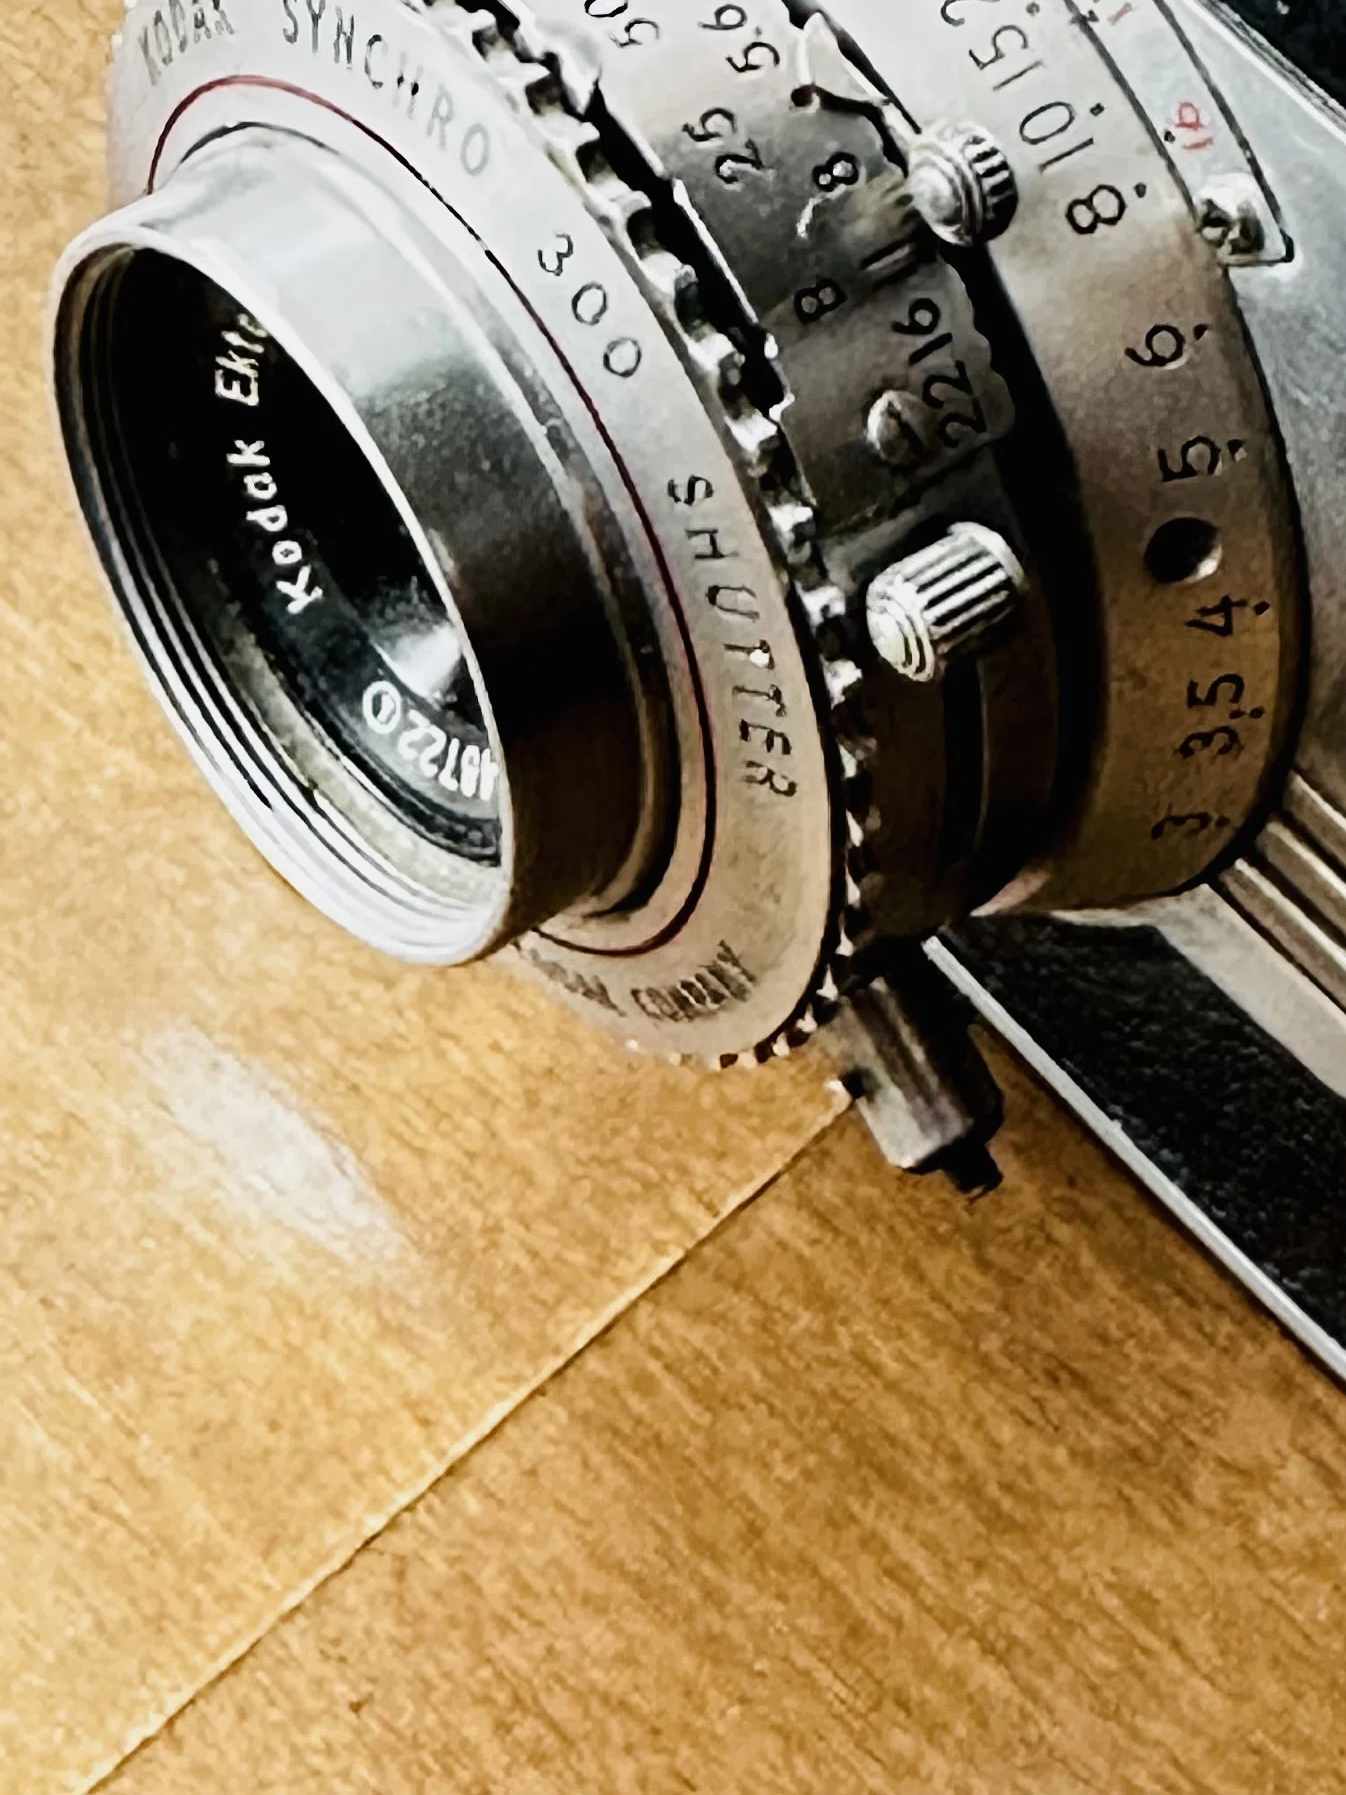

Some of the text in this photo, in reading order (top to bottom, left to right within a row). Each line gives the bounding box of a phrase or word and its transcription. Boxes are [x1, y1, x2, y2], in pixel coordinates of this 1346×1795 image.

[698, 4, 780, 75] 5.6
[968, 24, 1045, 92] 15
[681, 106, 769, 187] 25
[1019, 100, 1095, 174] 10
[812, 151, 861, 192] 8
[1065, 183, 1126, 236] 8
[892, 298, 952, 365] 16
[1124, 323, 1186, 369] 6
[922, 360, 988, 449] 22
[1157, 435, 1222, 482] 5
[226, 439, 324, 615] Kodak
[537, 229, 643, 379] 300
[667, 474, 797, 799] SHUTTER
[1184, 594, 1248, 638] 4
